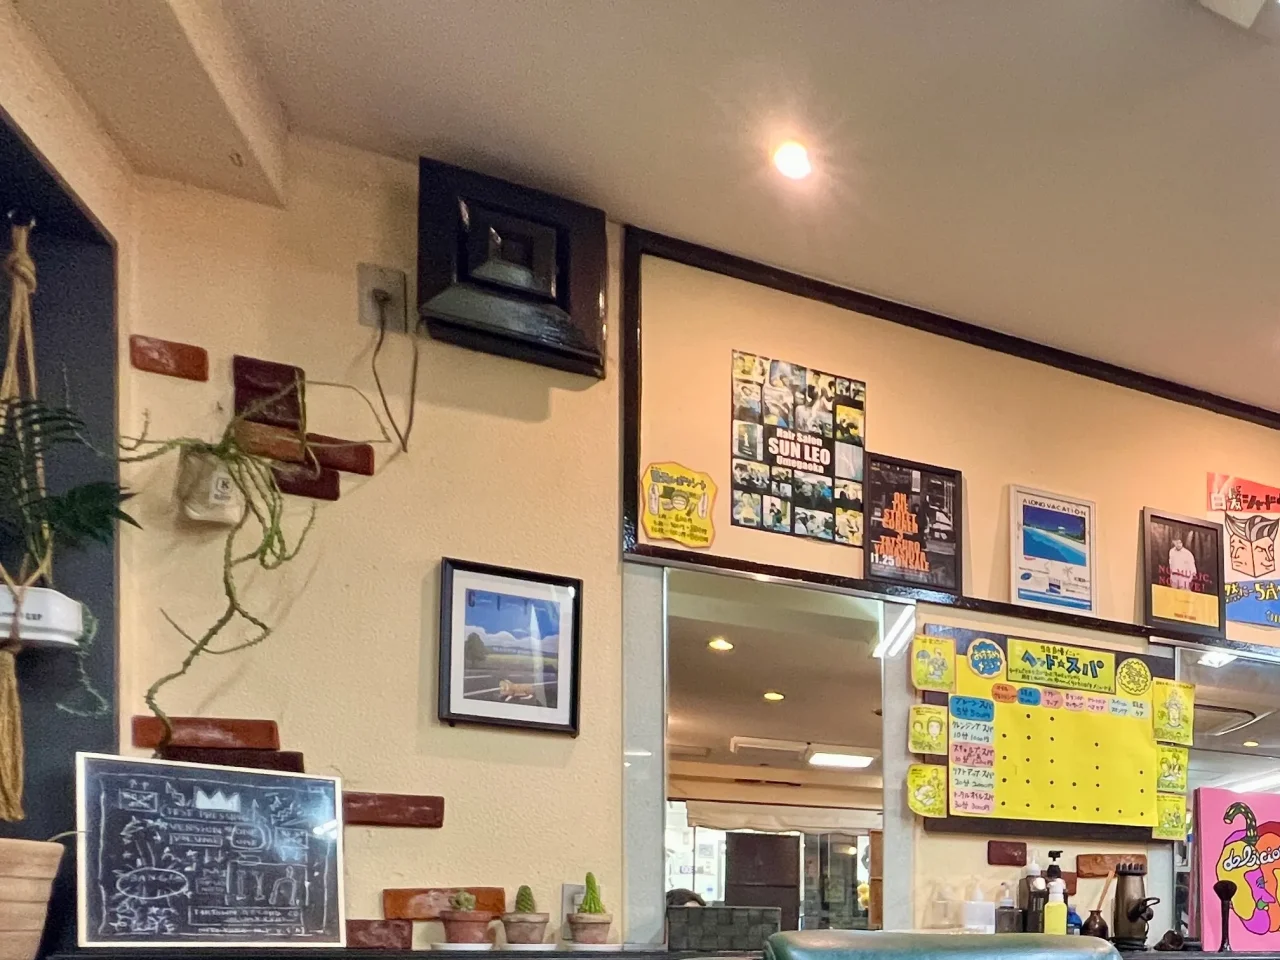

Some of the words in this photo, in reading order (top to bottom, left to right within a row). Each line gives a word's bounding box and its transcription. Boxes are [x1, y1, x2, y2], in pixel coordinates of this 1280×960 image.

[777, 428, 795, 440] Hair
[797, 432, 823, 447] Salon
[768, 437, 800, 458] SUN
[804, 444, 831, 465] LEO
[1028, 500, 1046, 508] LONG
[1047, 503, 1087, 517] VACATION
[870, 552, 895, 567] 11.25
[1158, 564, 1172, 575] NO
[1158, 575, 1171, 586] NO
